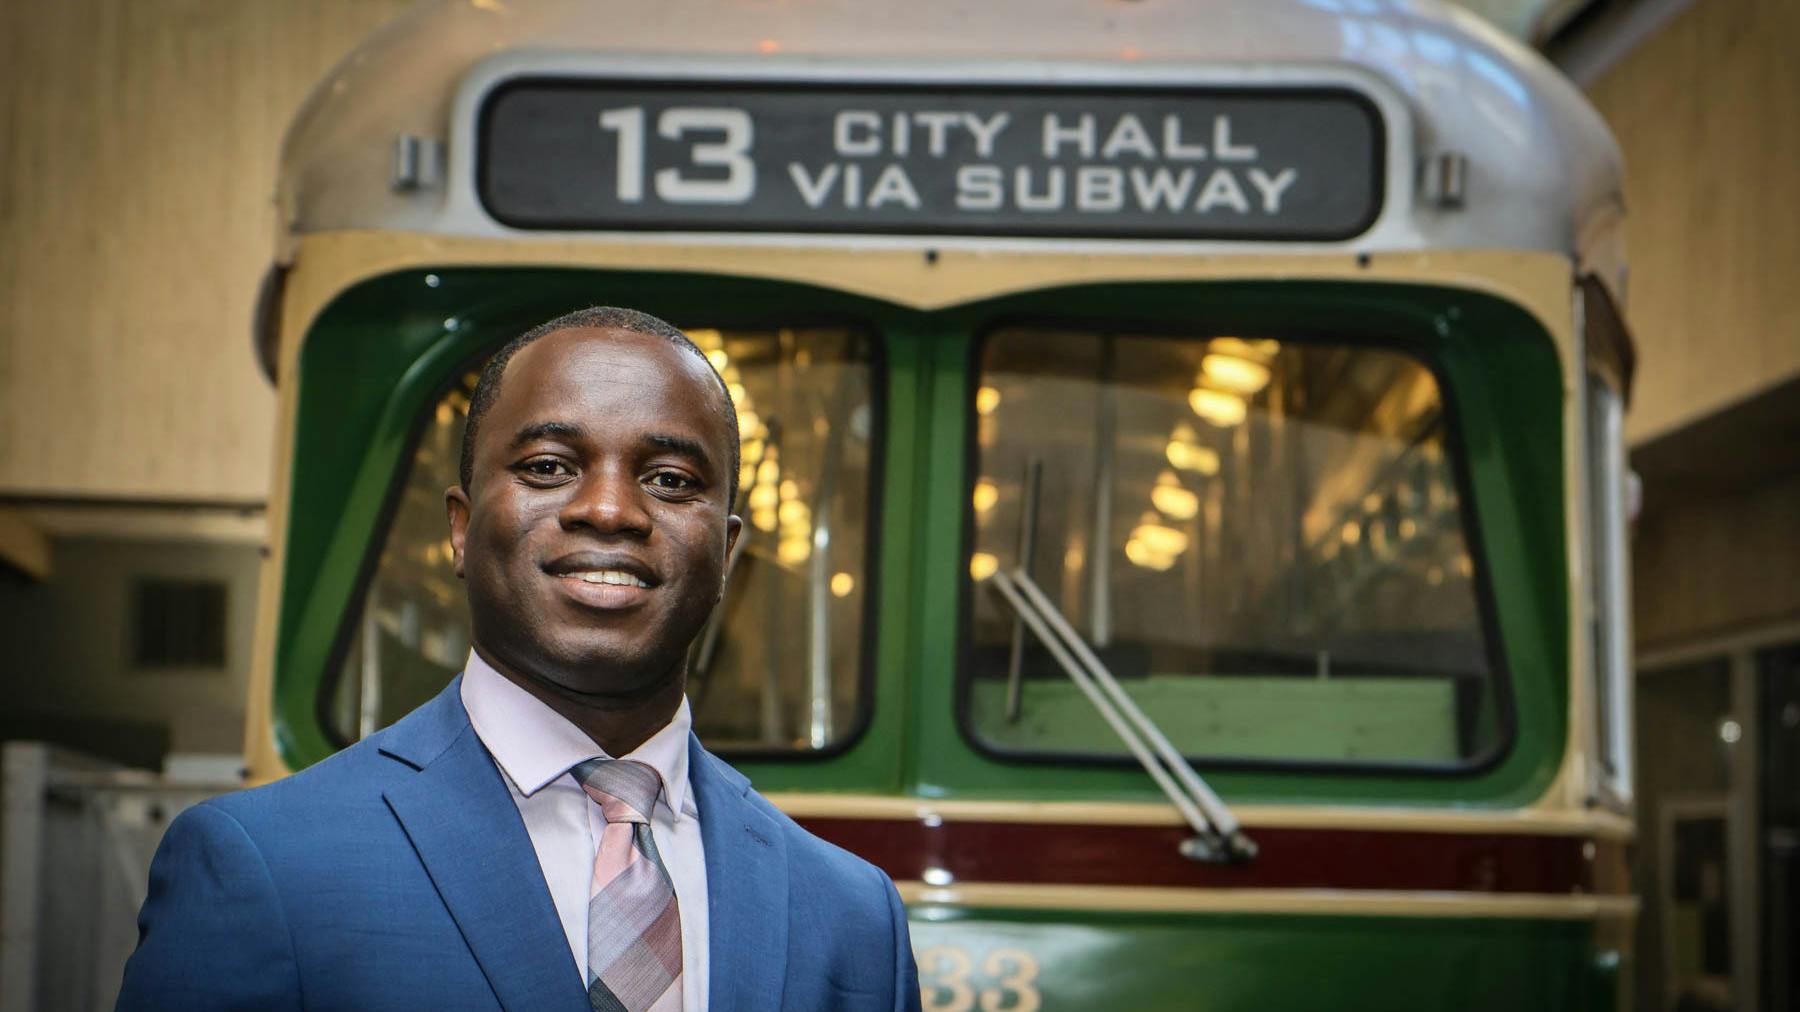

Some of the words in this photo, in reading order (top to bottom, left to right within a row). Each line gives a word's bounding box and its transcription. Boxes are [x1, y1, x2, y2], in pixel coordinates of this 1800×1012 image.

[600, 107, 756, 203] 13
[834, 111, 1009, 157] CITY
[1043, 113, 1258, 160] HALL
[789, 163, 922, 208] VIA
[955, 165, 1296, 213] SUBWAY
